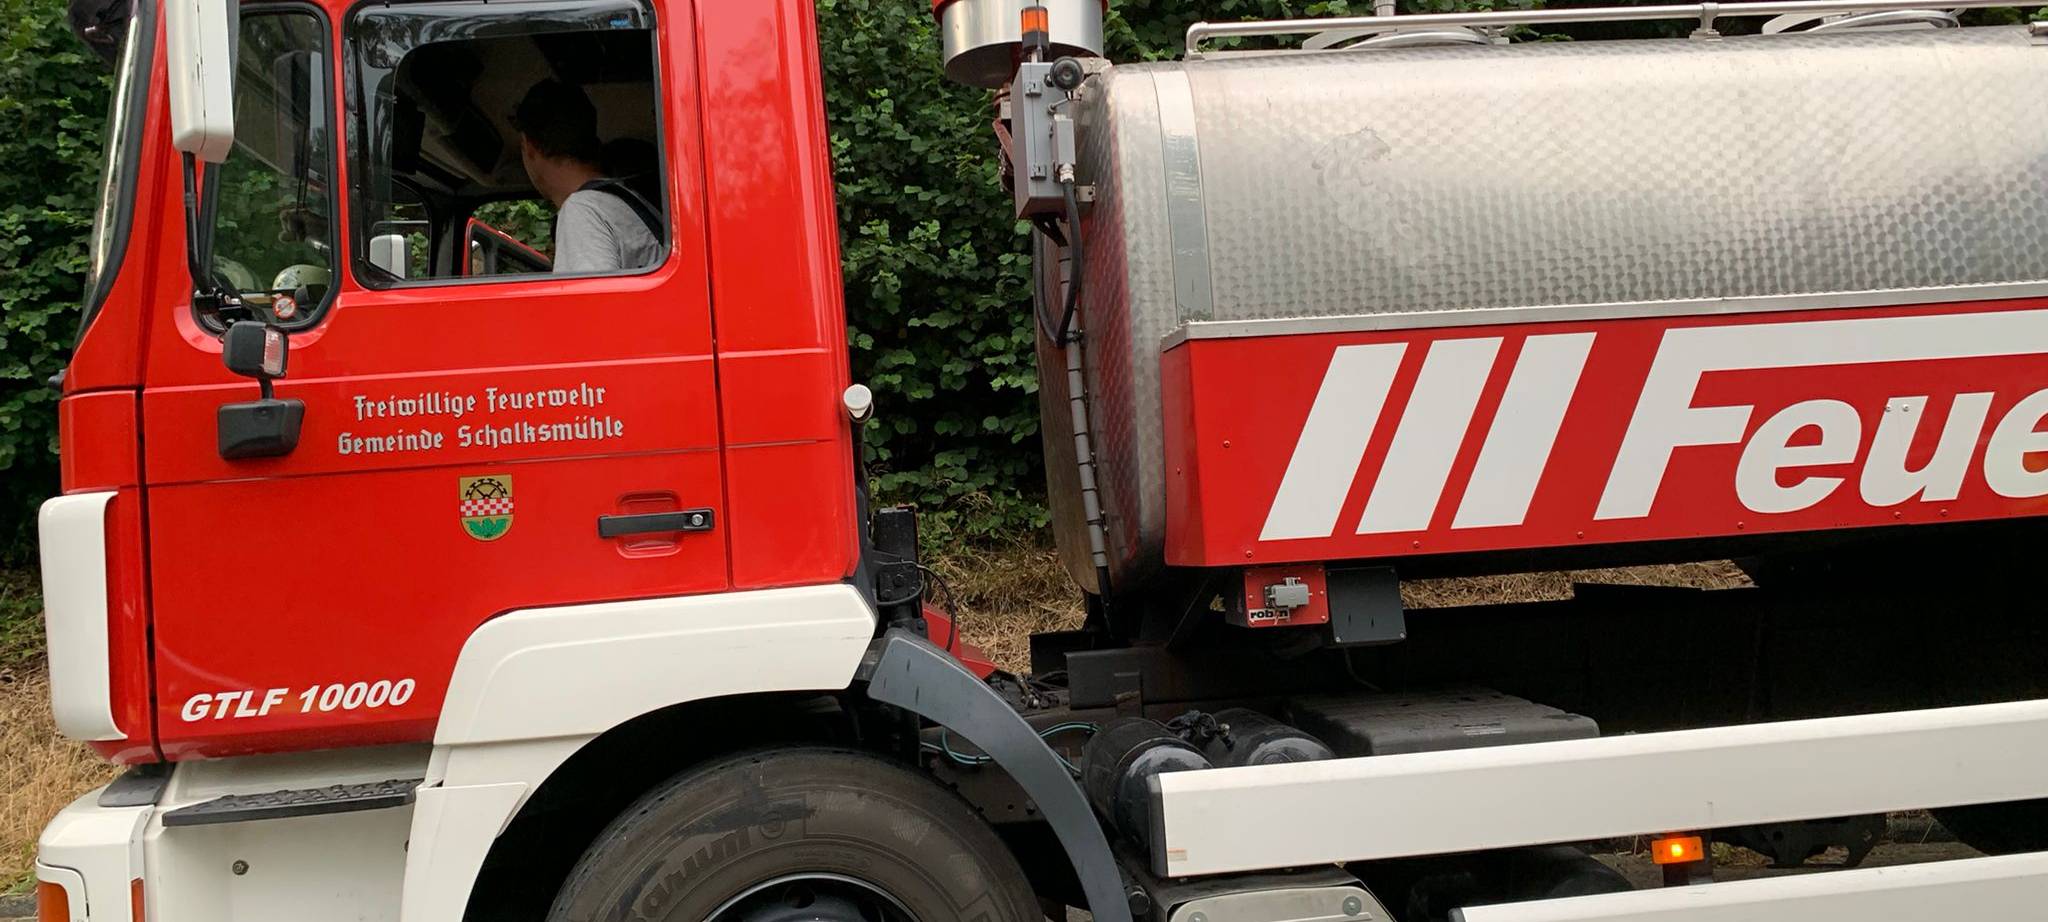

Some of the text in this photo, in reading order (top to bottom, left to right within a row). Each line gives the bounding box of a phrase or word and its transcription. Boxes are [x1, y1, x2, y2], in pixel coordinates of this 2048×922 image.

[353, 382, 607, 421] Freiwillige Feuerwehr
[338, 415, 625, 455] Gemeinde Schalksmühle
[181, 678, 416, 722] GTLF 10000
[618, 825, 752, 922] arum
